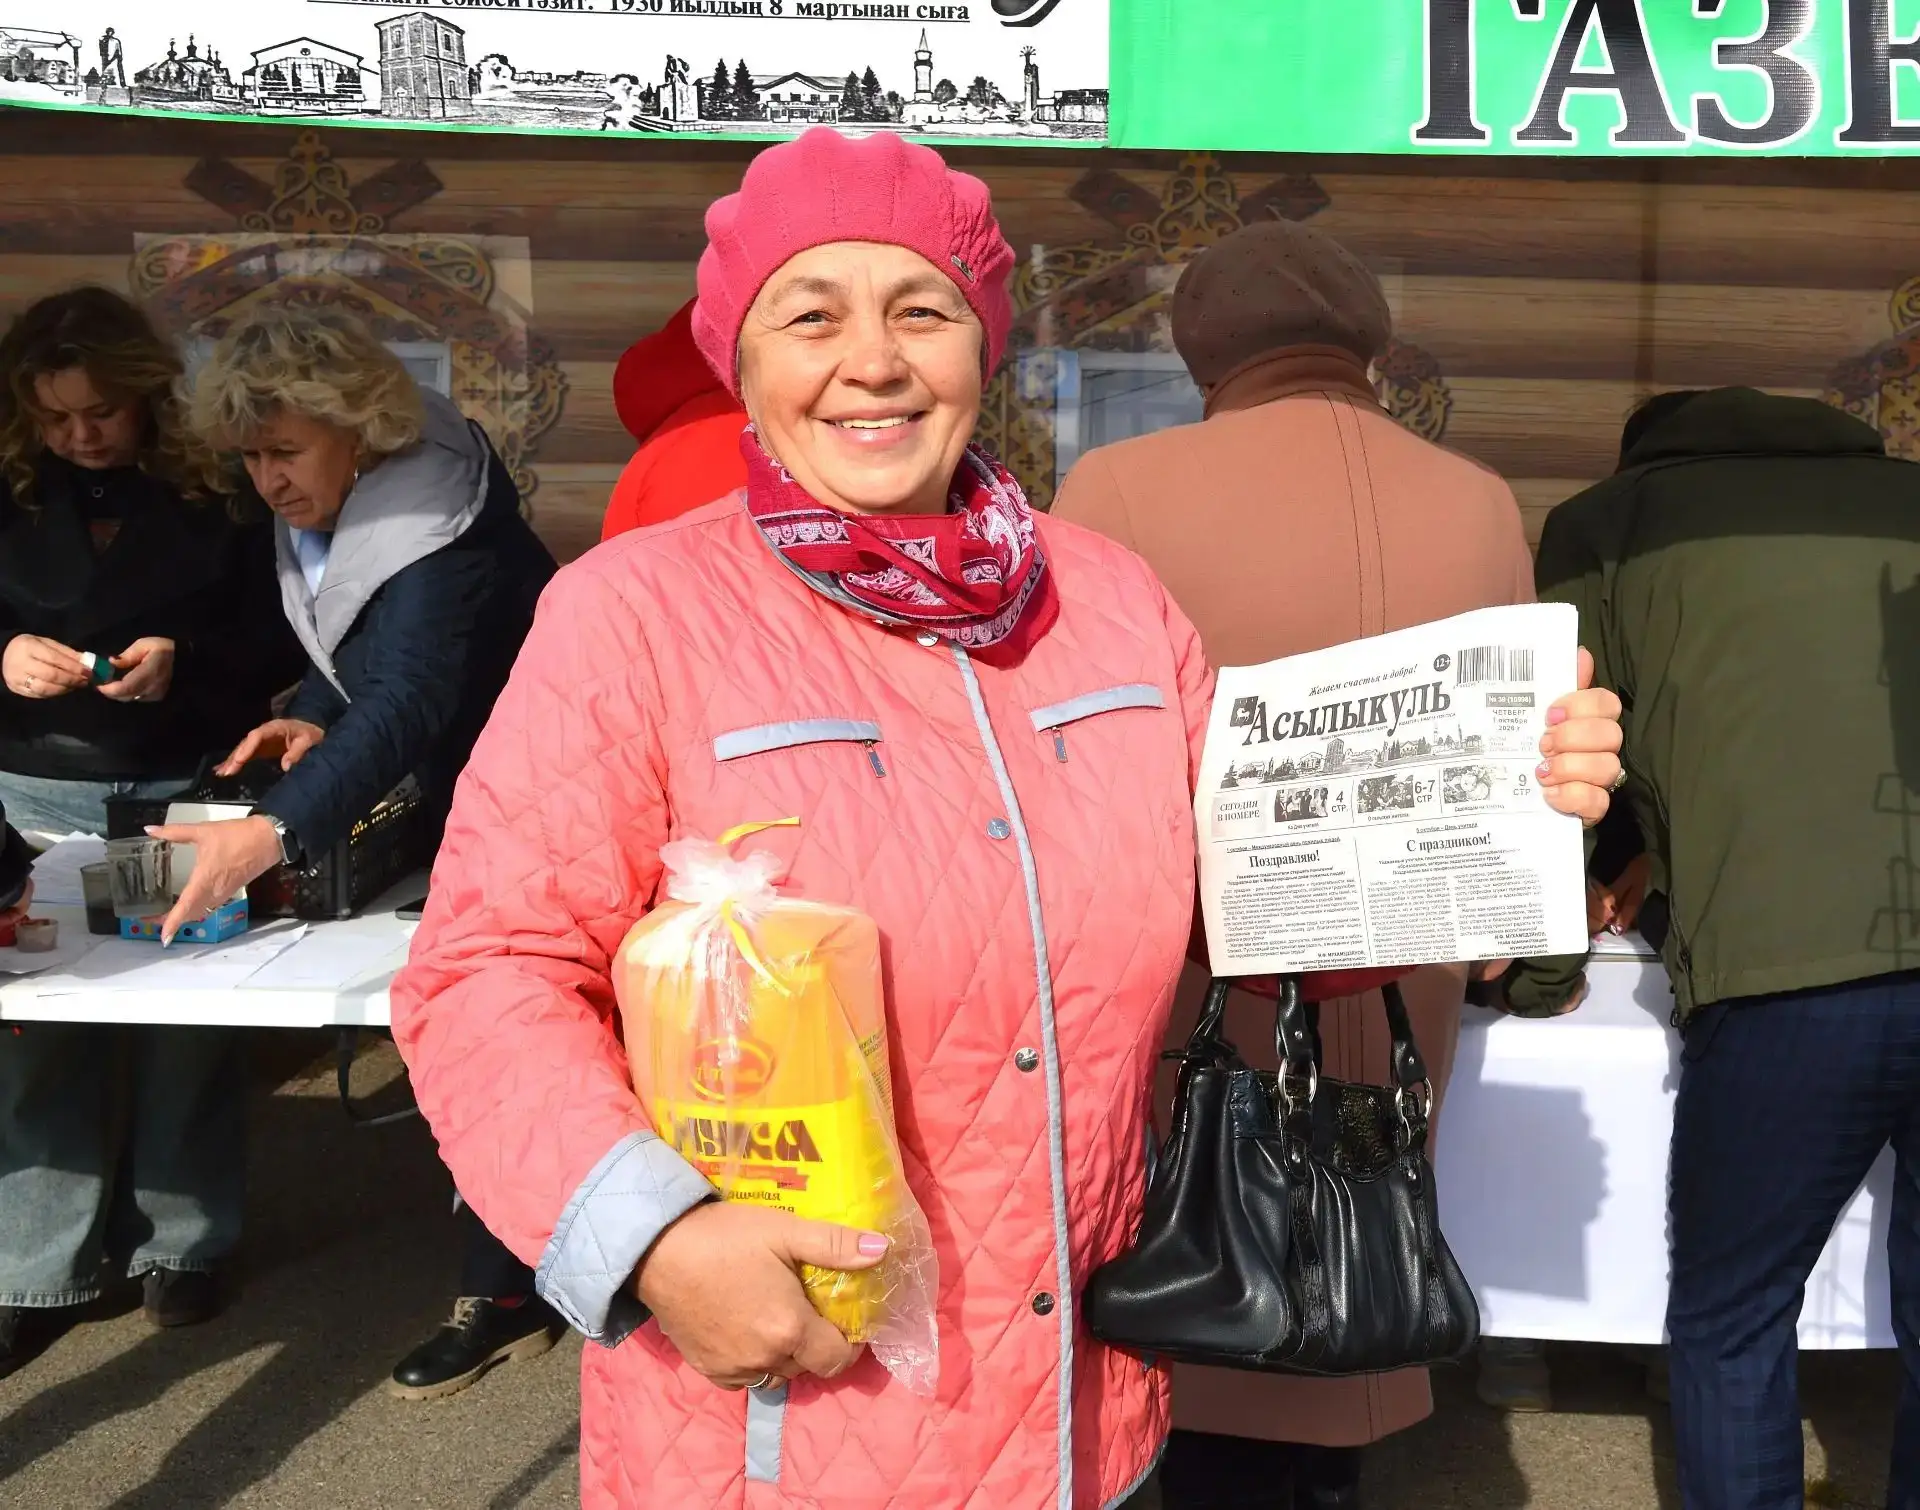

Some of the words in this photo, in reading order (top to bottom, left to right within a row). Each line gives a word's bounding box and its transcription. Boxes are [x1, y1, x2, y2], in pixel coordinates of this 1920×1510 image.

[769, 0, 783, 15] 8
[795, 2, 909, 20] мартынан
[916, 5, 970, 19] сыға
[1435, 656, 1451, 669] 12+
[1308, 683, 1342, 697] Желаем
[1343, 674, 1381, 690] счастья
[1382, 672, 1389, 682] и
[1389, 663, 1419, 681] добра!
[1241, 681, 1451, 747] Асылыкуль
[1498, 717, 1528, 725] октября
[1414, 779, 1436, 794] 6-7
[1518, 774, 1528, 787] 9
[1336, 790, 1344, 803] 4
[1219, 800, 1258, 812] СЕГОДНЯ
[1217, 814, 1224, 822] В
[1225, 810, 1260, 821] НОМЕРЕ
[1406, 839, 1417, 852] С
[1419, 832, 1492, 854] праздником!
[1248, 849, 1321, 868] Поздравляю!
